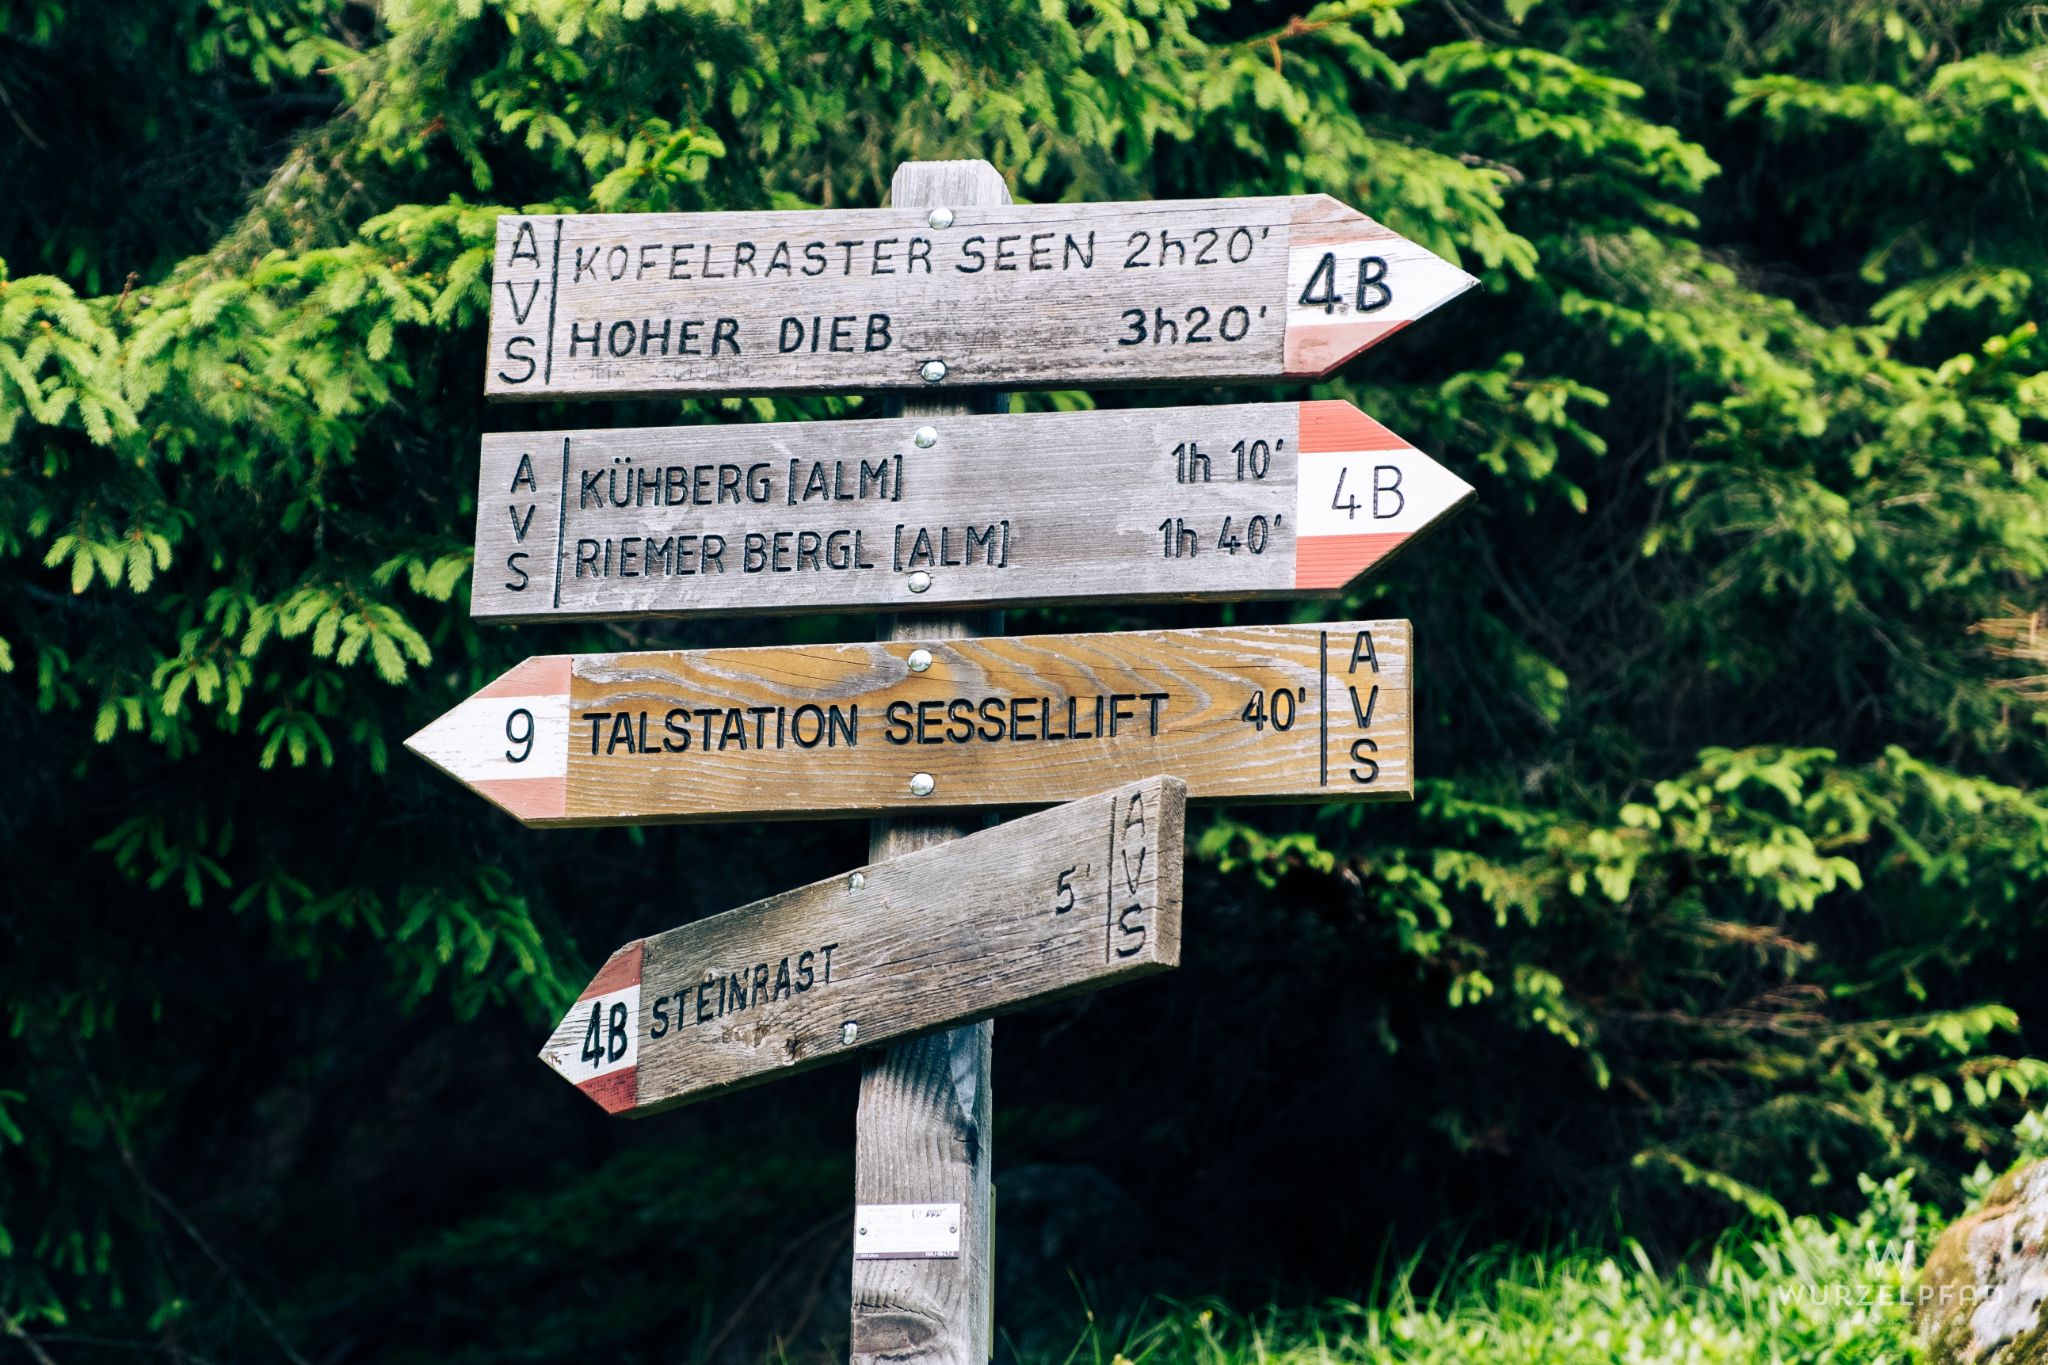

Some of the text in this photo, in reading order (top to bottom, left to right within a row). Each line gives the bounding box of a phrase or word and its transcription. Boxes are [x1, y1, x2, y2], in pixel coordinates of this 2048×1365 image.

[574, 226, 1271, 284] KOFELRASTER SEEN 2h20'
[1298, 252, 1393, 315] 4B
[499, 220, 540, 385] AVS
[1117, 305, 1268, 347] 3h20'
[569, 313, 893, 359] HOHER DIEB
[580, 454, 903, 510] KÜHBERG [ALM]
[1171, 438, 1285, 484] 1h 10'
[1331, 465, 1406, 520] 4B
[504, 453, 537, 593] AVS
[574, 520, 1010, 580] RIEMER BERGL [ALM]
[1158, 513, 1283, 559] 1h 40'
[505, 707, 535, 764] 9
[582, 687, 1306, 756] TALSTATION SESSELLIFT 40'
[1348, 629, 1380, 785] AVS
[1116, 790, 1147, 958] AVS
[650, 943, 839, 1041] STEINRAST
[580, 1001, 629, 1070] 4B
